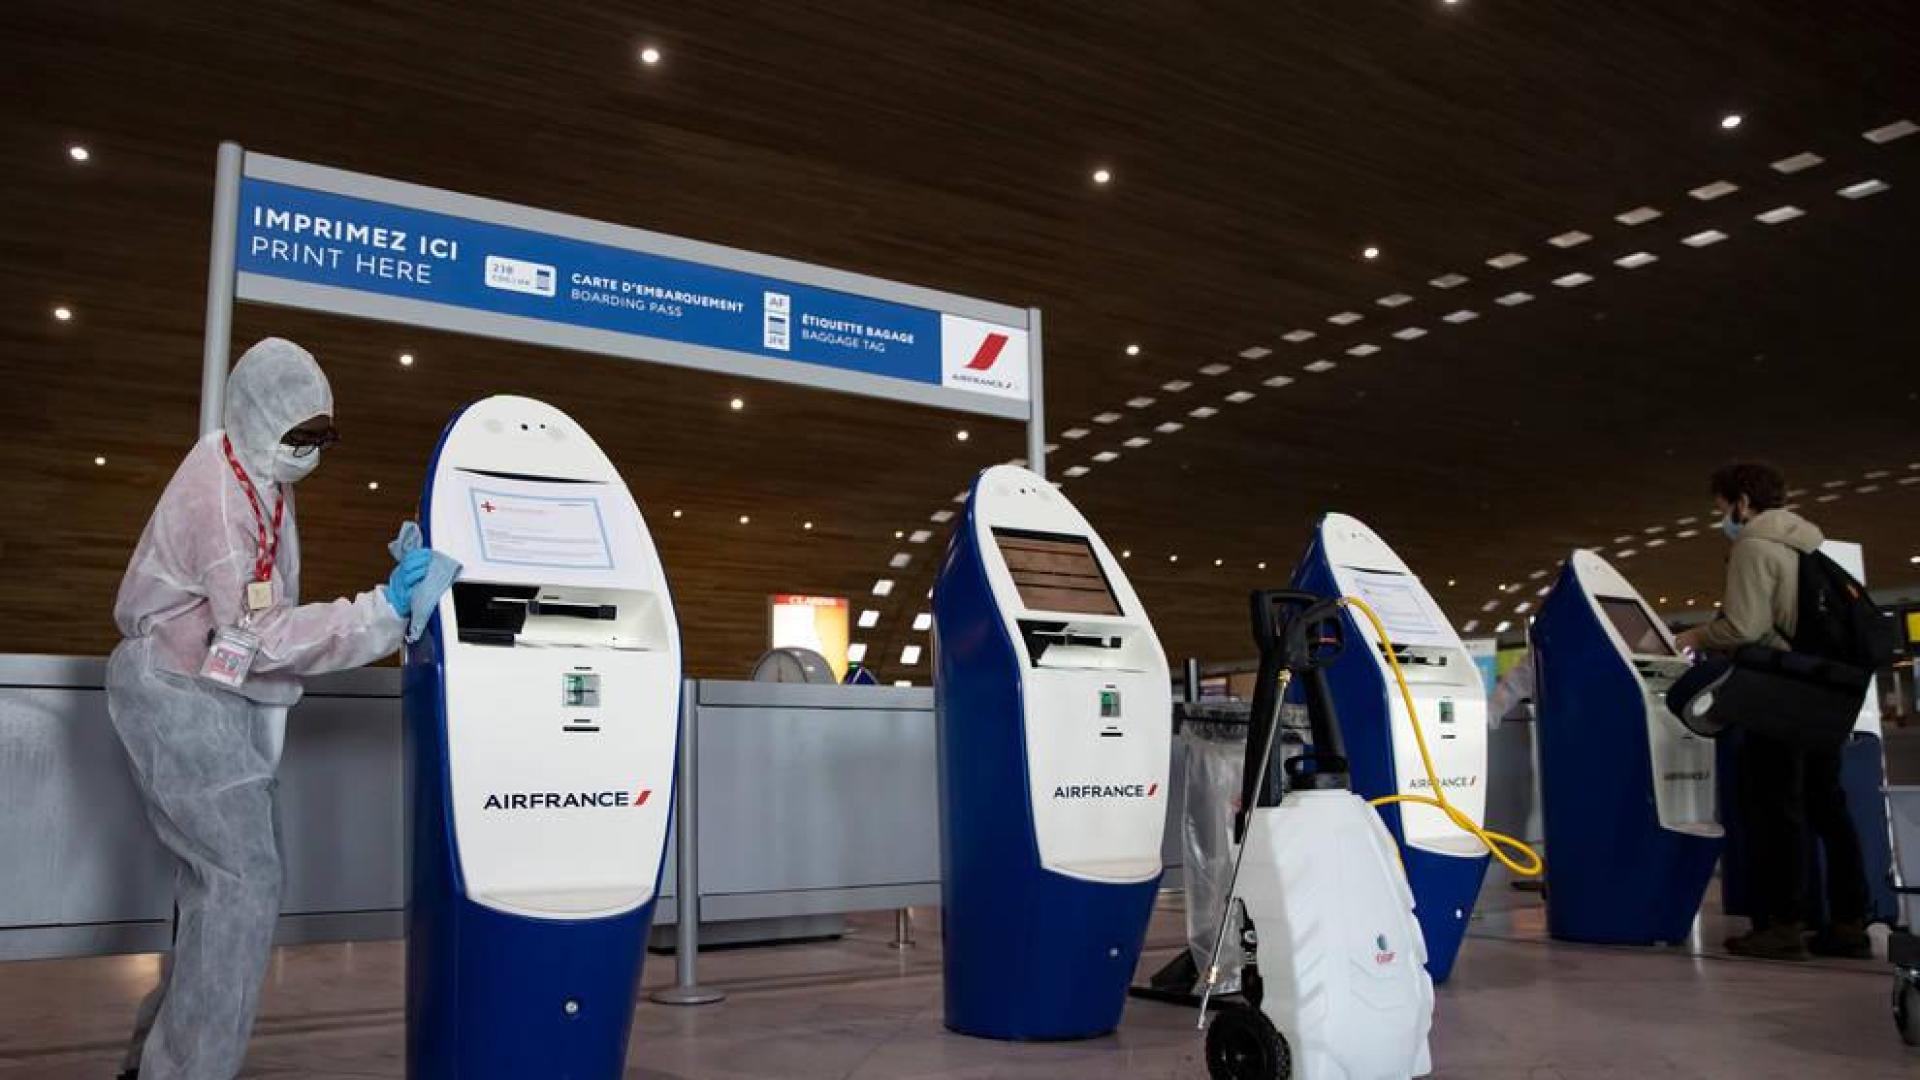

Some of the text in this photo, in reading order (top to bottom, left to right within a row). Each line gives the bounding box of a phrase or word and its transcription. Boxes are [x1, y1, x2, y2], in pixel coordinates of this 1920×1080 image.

[253, 205, 458, 261] IMPRIMEZ ICI
[251, 235, 432, 284] PRINT HERE
[571, 272, 744, 314] CARTE D'EMBARQUEMENT
[571, 288, 683, 317] BOARDING PASS
[769, 296, 786, 308] AF
[802, 313, 914, 345] ÉTIQUETTE BAGAGE
[802, 328, 885, 353] BAGGAGE TAG
[483, 791, 629, 809] AIRFRANCE
[1054, 784, 1145, 799] AIRFRANCE
